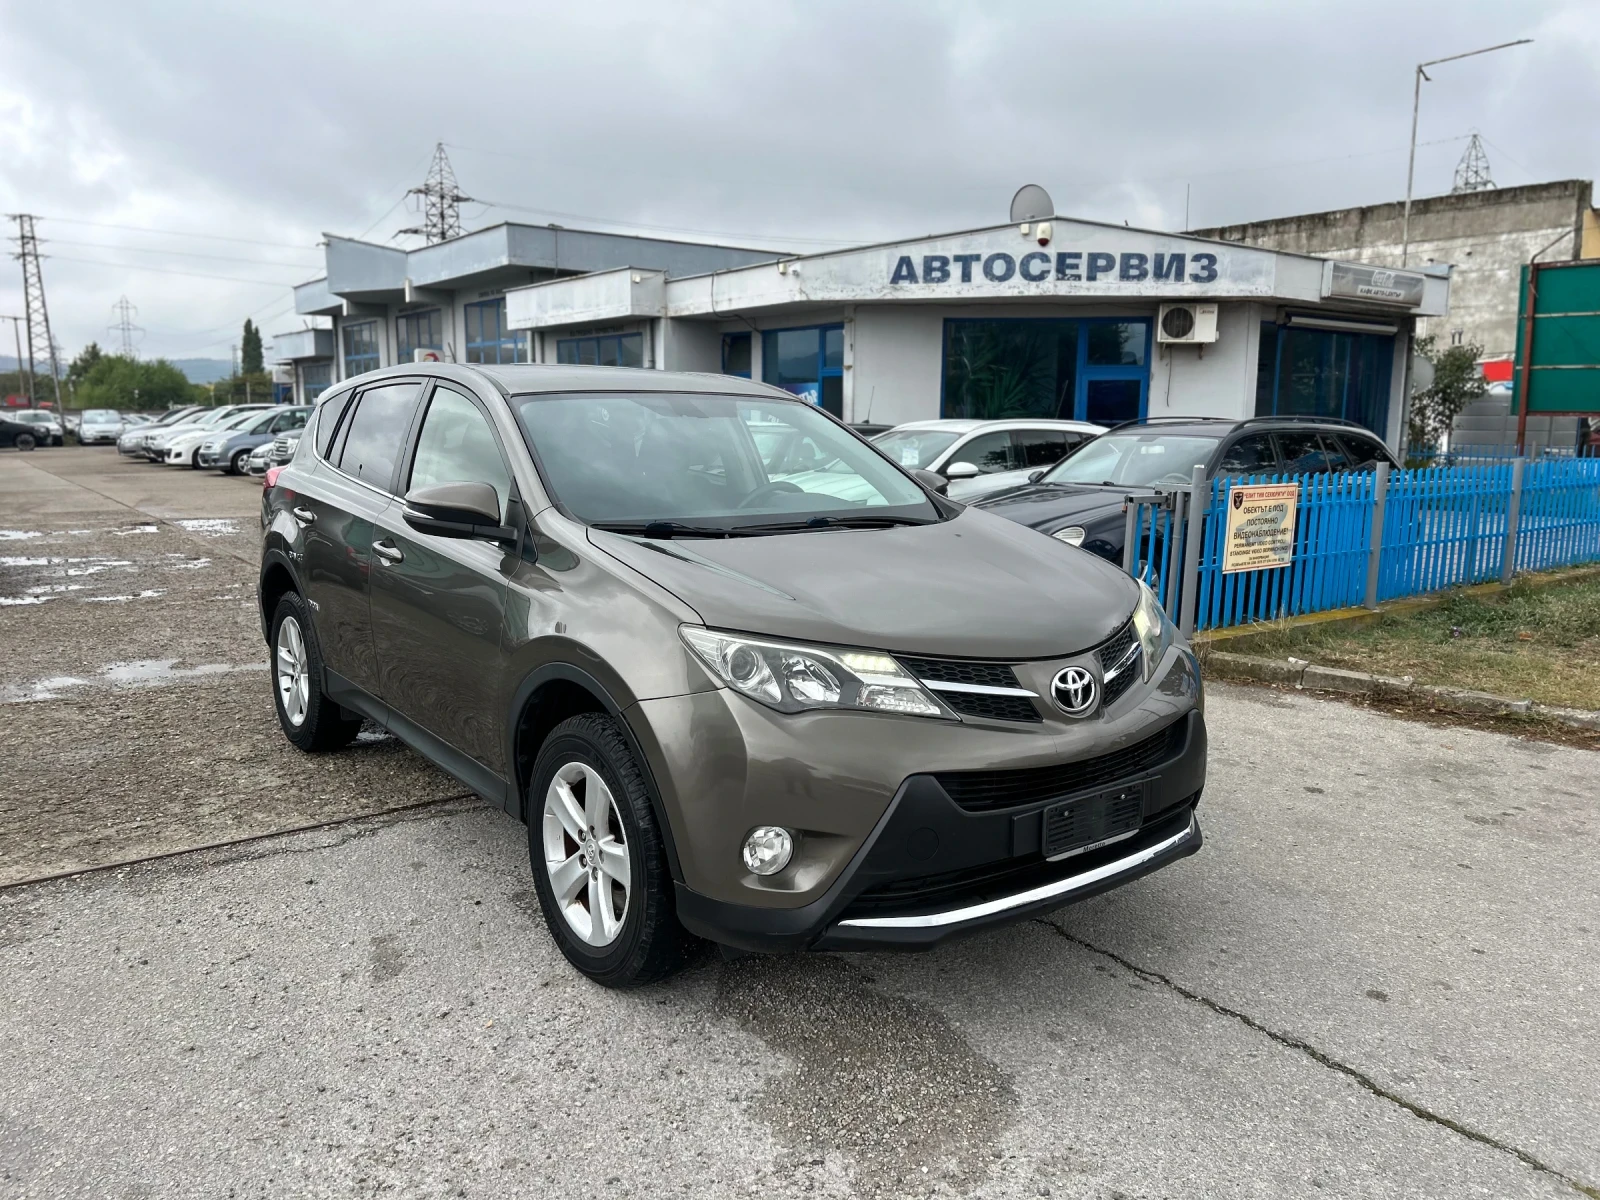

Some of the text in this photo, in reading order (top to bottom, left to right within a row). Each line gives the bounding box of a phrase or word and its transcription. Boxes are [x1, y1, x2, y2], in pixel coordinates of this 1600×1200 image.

[889, 251, 1218, 285] АВТОСЕРВИЗ
[1243, 505, 1268, 515] ОБЕКТЪТ
[1272, 504, 1284, 513] ПОД
[1246, 517, 1279, 527] ПОСТОЯННО
[1233, 541, 1257, 549] PERMANENT
